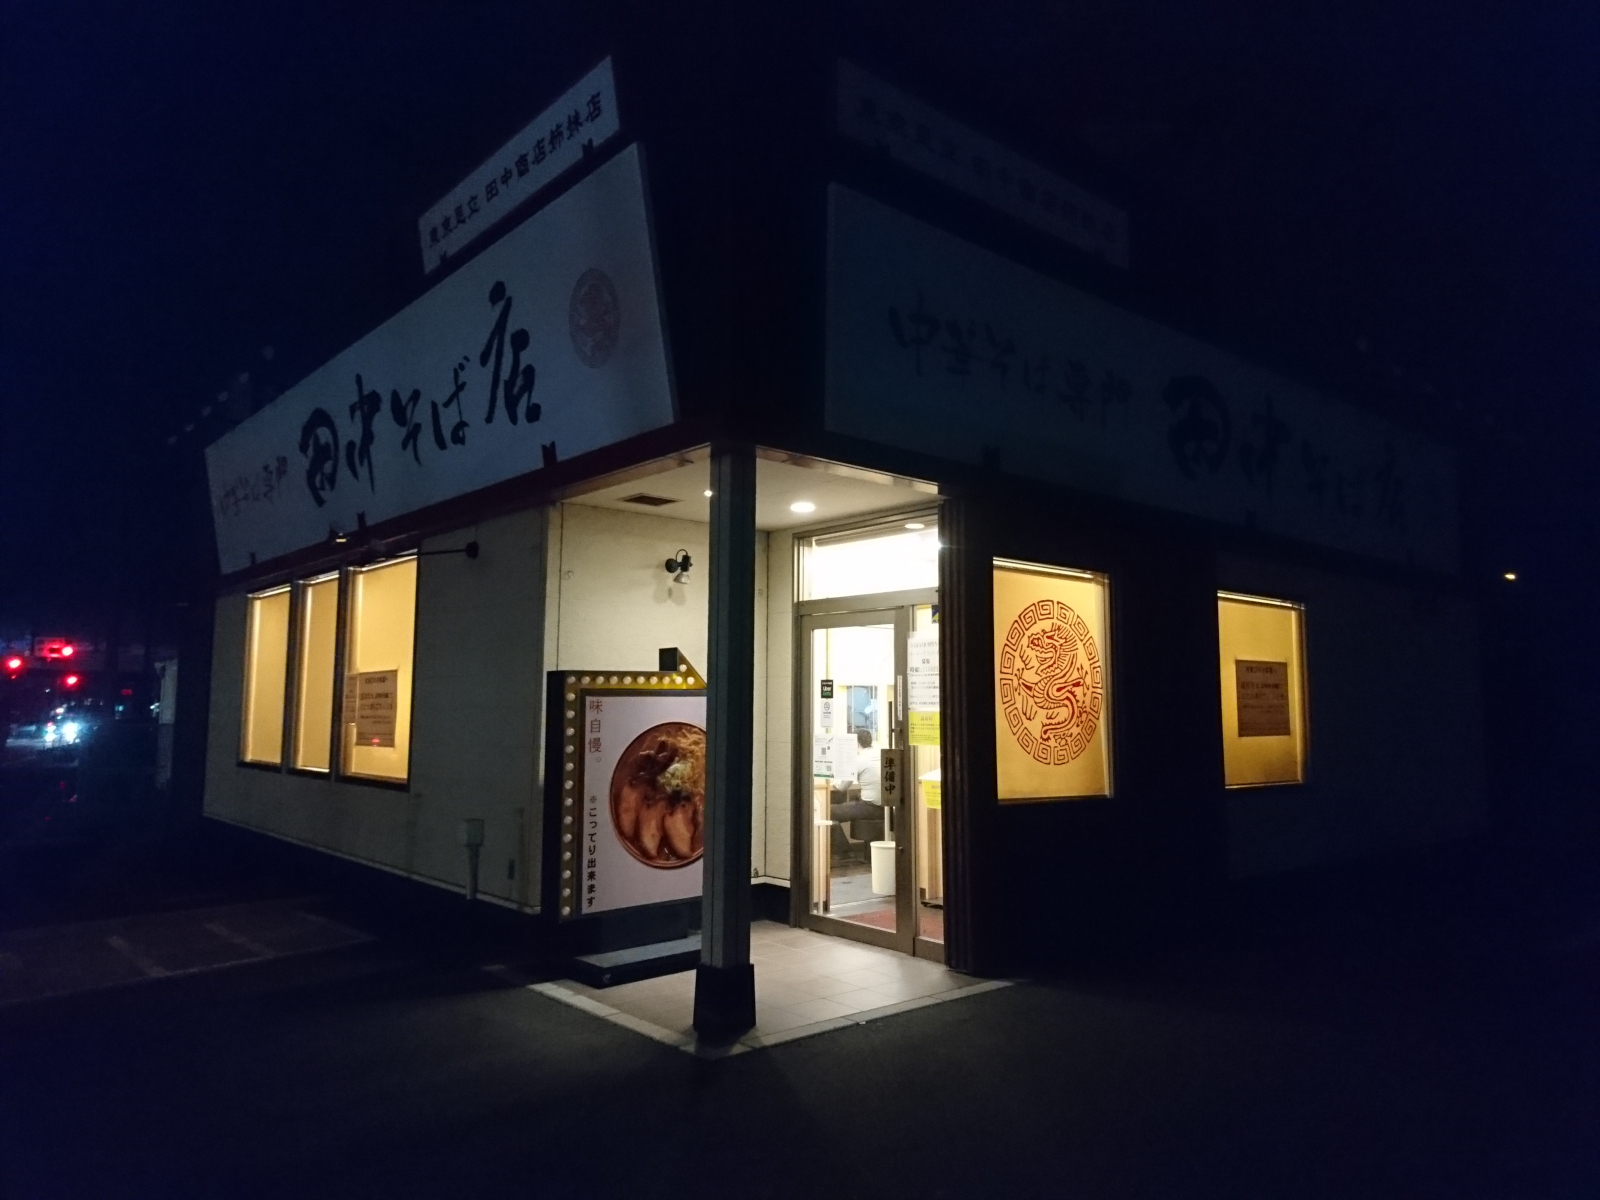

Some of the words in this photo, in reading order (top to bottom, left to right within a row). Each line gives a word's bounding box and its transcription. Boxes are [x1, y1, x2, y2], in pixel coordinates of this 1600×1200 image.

[485, 91, 602, 202] 田中商店姉妹店
[299, 280, 541, 507] 田中そば店
[884, 756, 896, 795] 準備中
